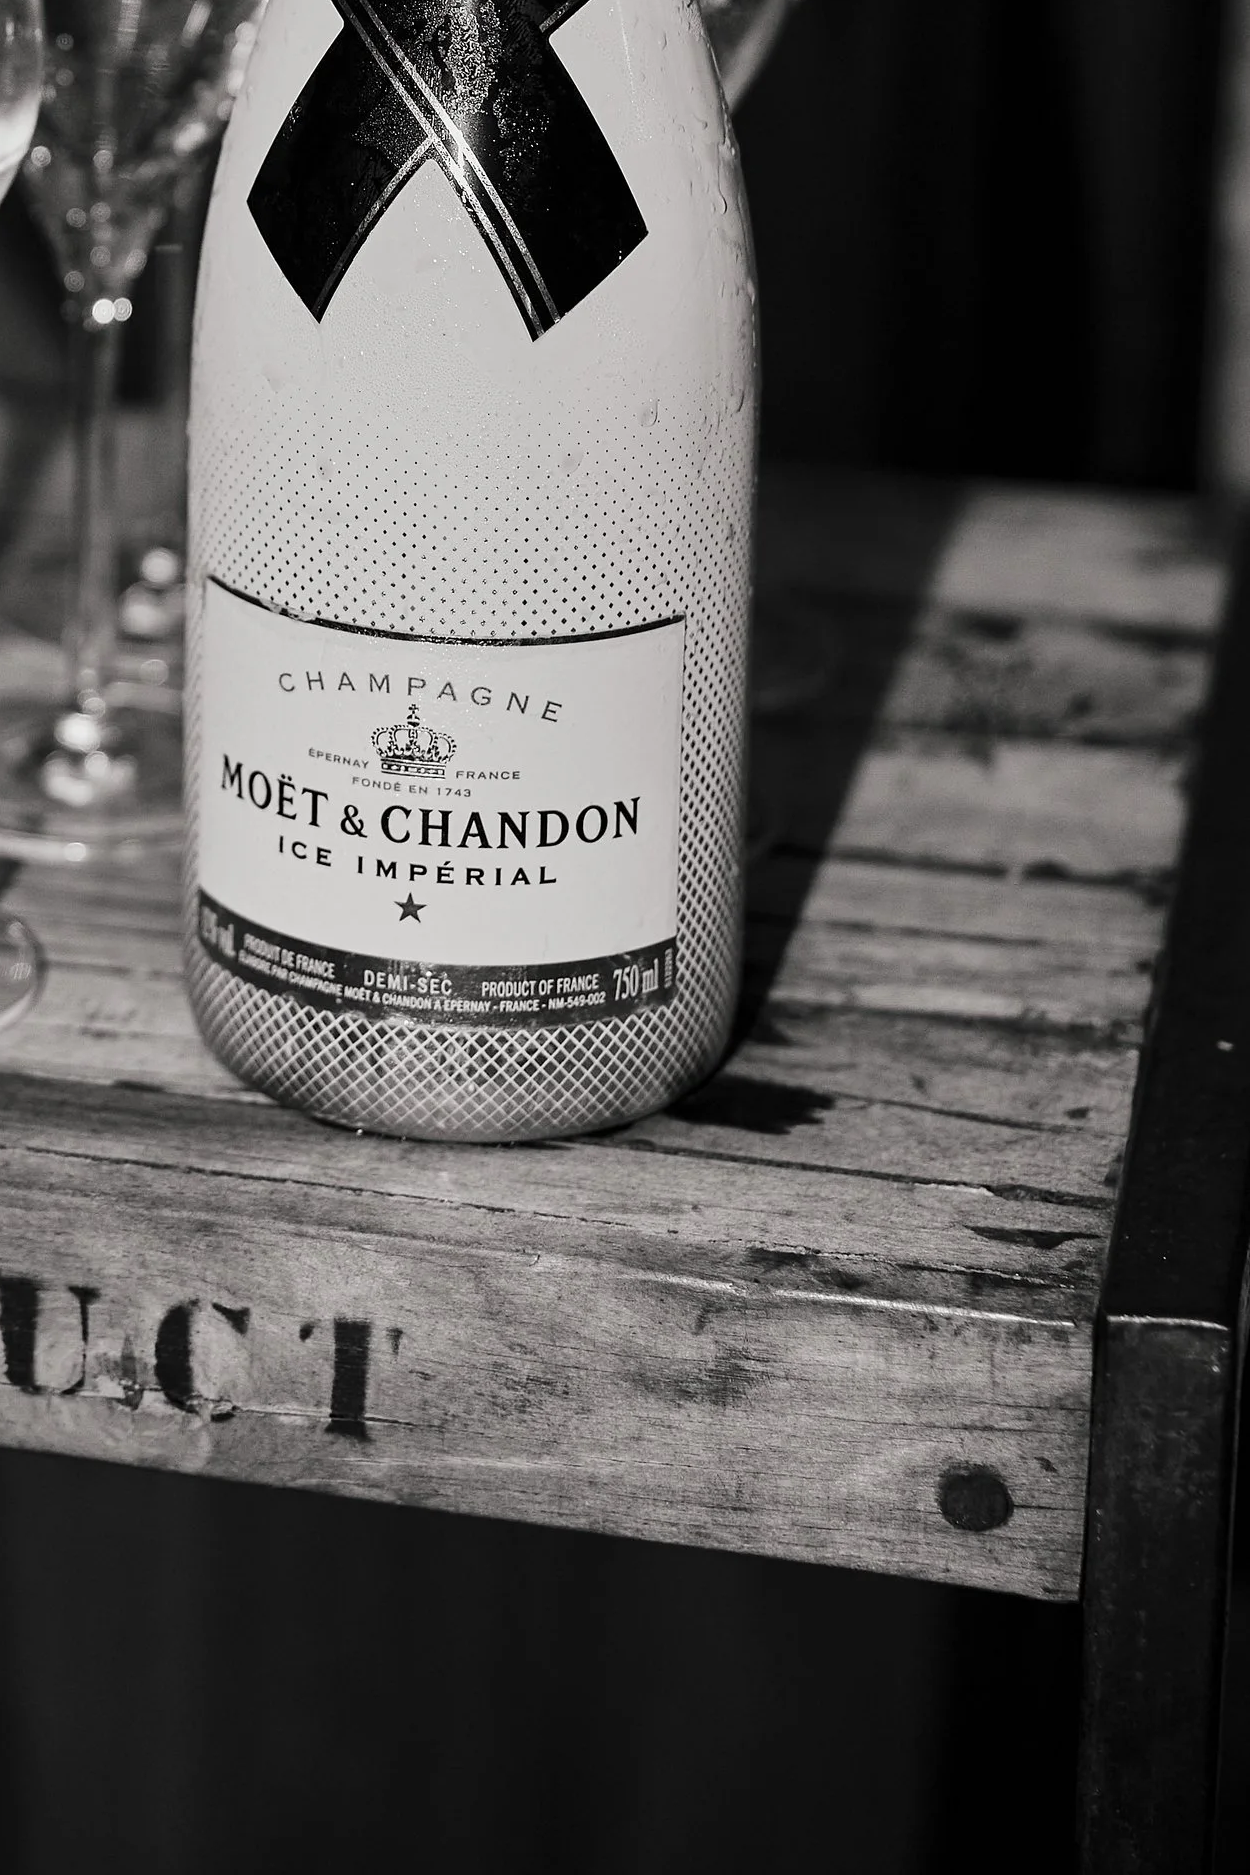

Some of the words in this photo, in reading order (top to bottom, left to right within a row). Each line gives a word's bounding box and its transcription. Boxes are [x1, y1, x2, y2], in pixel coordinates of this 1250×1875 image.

[278, 671, 563, 722] CHAMPAGNE
[307, 747, 370, 770] ÉPERNAY
[455, 770, 521, 781] FRANCE
[220, 753, 329, 828] MOËT
[340, 804, 368, 838] &
[380, 796, 642, 849] CHANDON
[351, 776, 402, 792] FONDÉ
[409, 785, 428, 795] EN
[436, 787, 473, 798] 1743
[278, 835, 333, 867] ICE
[356, 855, 558, 886] IMPÉRIAL
[295, 954, 336, 980] FRANCE
[612, 964, 640, 1002] 750
[642, 958, 659, 993] ml
[363, 969, 453, 996] DEMI-SEC
[481, 980, 537, 998] PRODUCT
[538, 978, 555, 995] OF
[556, 973, 600, 994] FRANCE
[382, 993, 432, 1010] CHANDON
[499, 998, 541, 1013] FRANCE
[548, 992, 607, 1011] NM-549-002
